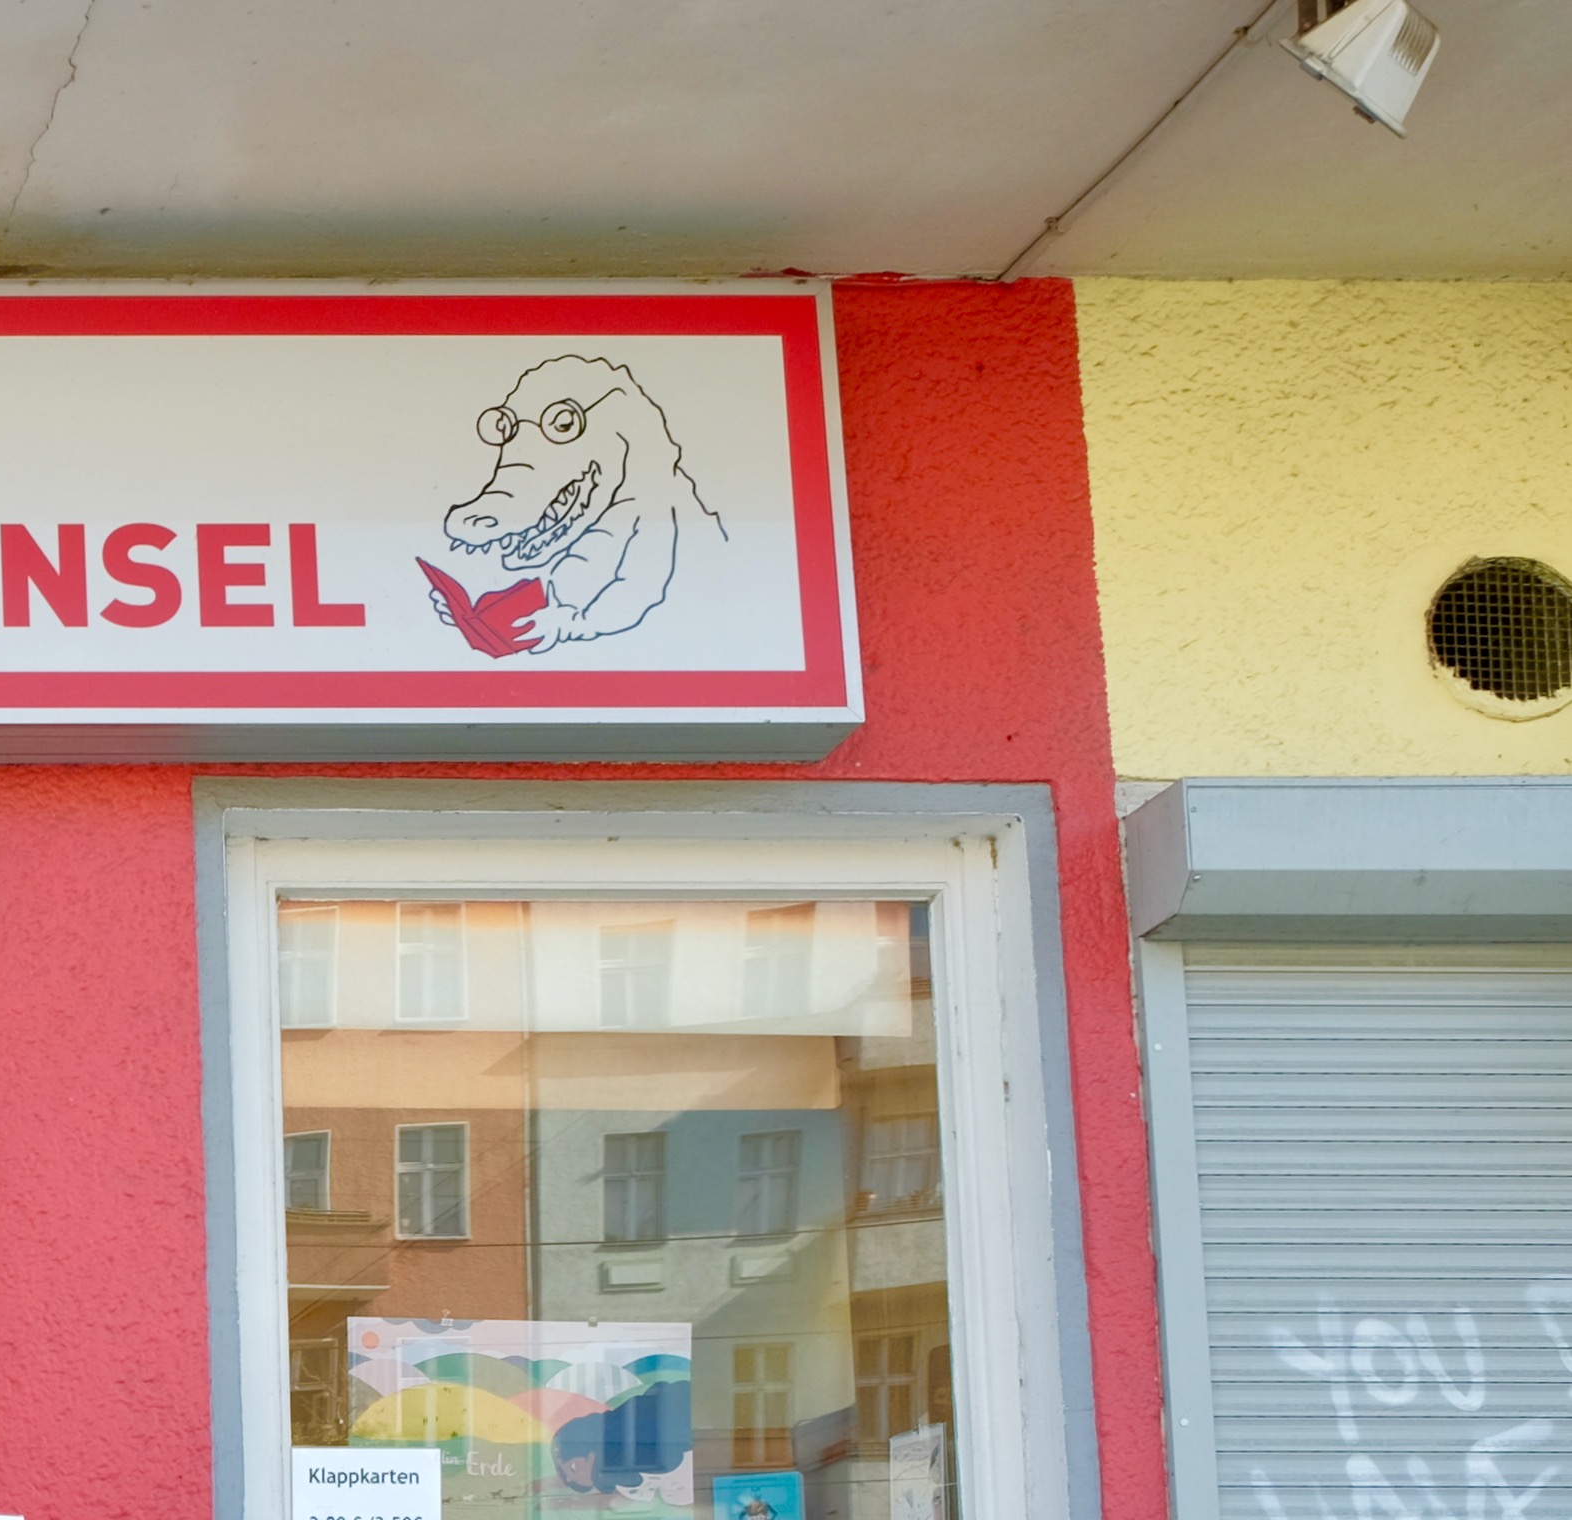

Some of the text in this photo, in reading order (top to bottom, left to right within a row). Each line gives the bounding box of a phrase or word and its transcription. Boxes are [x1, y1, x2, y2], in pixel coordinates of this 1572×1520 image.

[1267, 1293, 1489, 1440] YOU
[308, 1467, 420, 1487] Klappkarten
[466, 1451, 517, 1478] Erde
